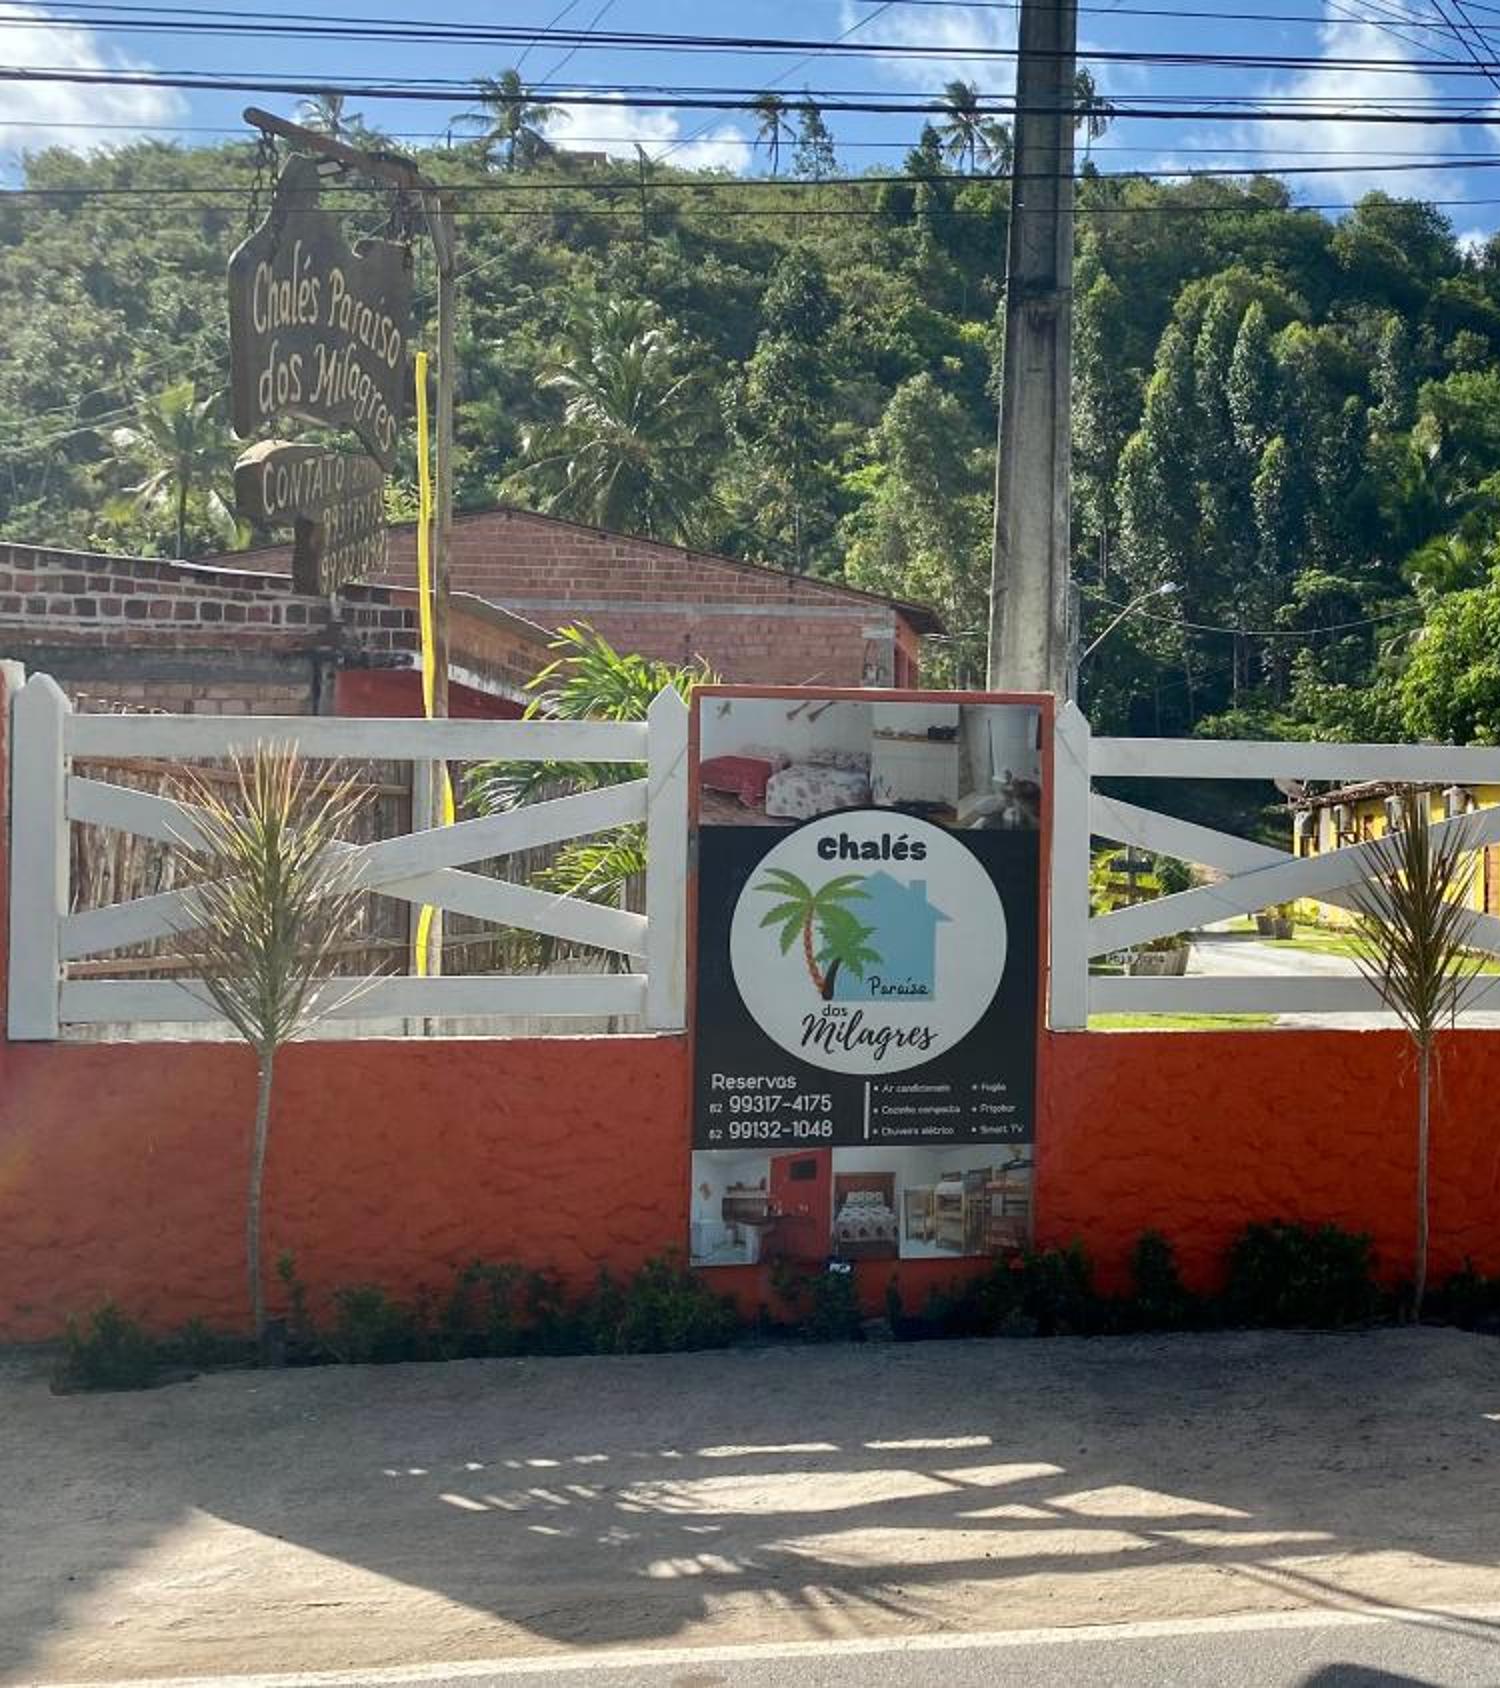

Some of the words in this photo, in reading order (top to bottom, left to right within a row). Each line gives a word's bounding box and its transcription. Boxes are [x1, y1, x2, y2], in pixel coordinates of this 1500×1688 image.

[254, 240, 320, 334] Chalés
[259, 338, 303, 414] dos
[309, 342, 396, 452] Milagres
[263, 454, 345, 515] CONTATO
[866, 975, 928, 996] Paraíso
[822, 1004, 848, 1017] dos
[801, 1009, 938, 1061] Milagres
[711, 1073, 797, 1090] Reservas
[729, 1094, 833, 1113] 99317-4175
[729, 1120, 833, 1139] 99132-1048
